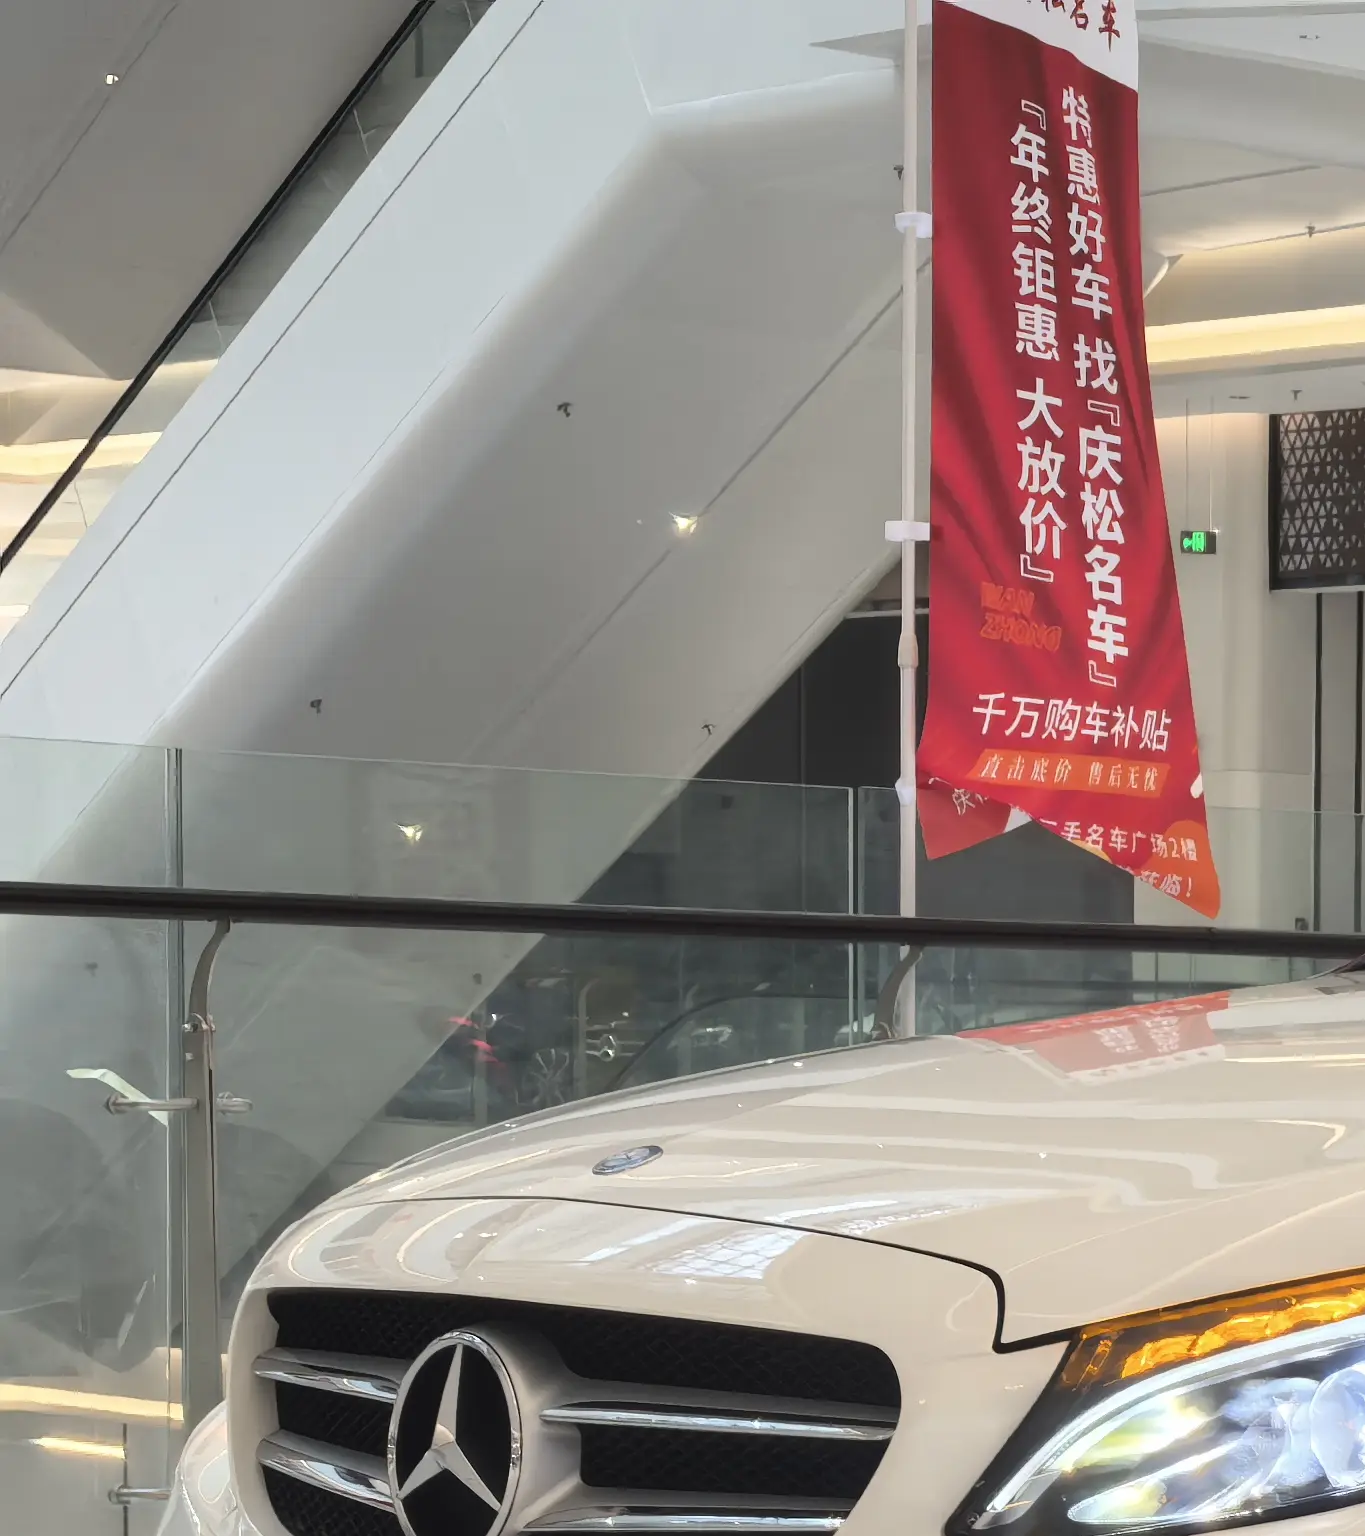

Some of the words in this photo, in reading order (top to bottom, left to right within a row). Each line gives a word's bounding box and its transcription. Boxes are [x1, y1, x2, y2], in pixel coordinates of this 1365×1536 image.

[1041, 0, 1120, 52] 名车
[973, 692, 1172, 752] 千万购车补贴
